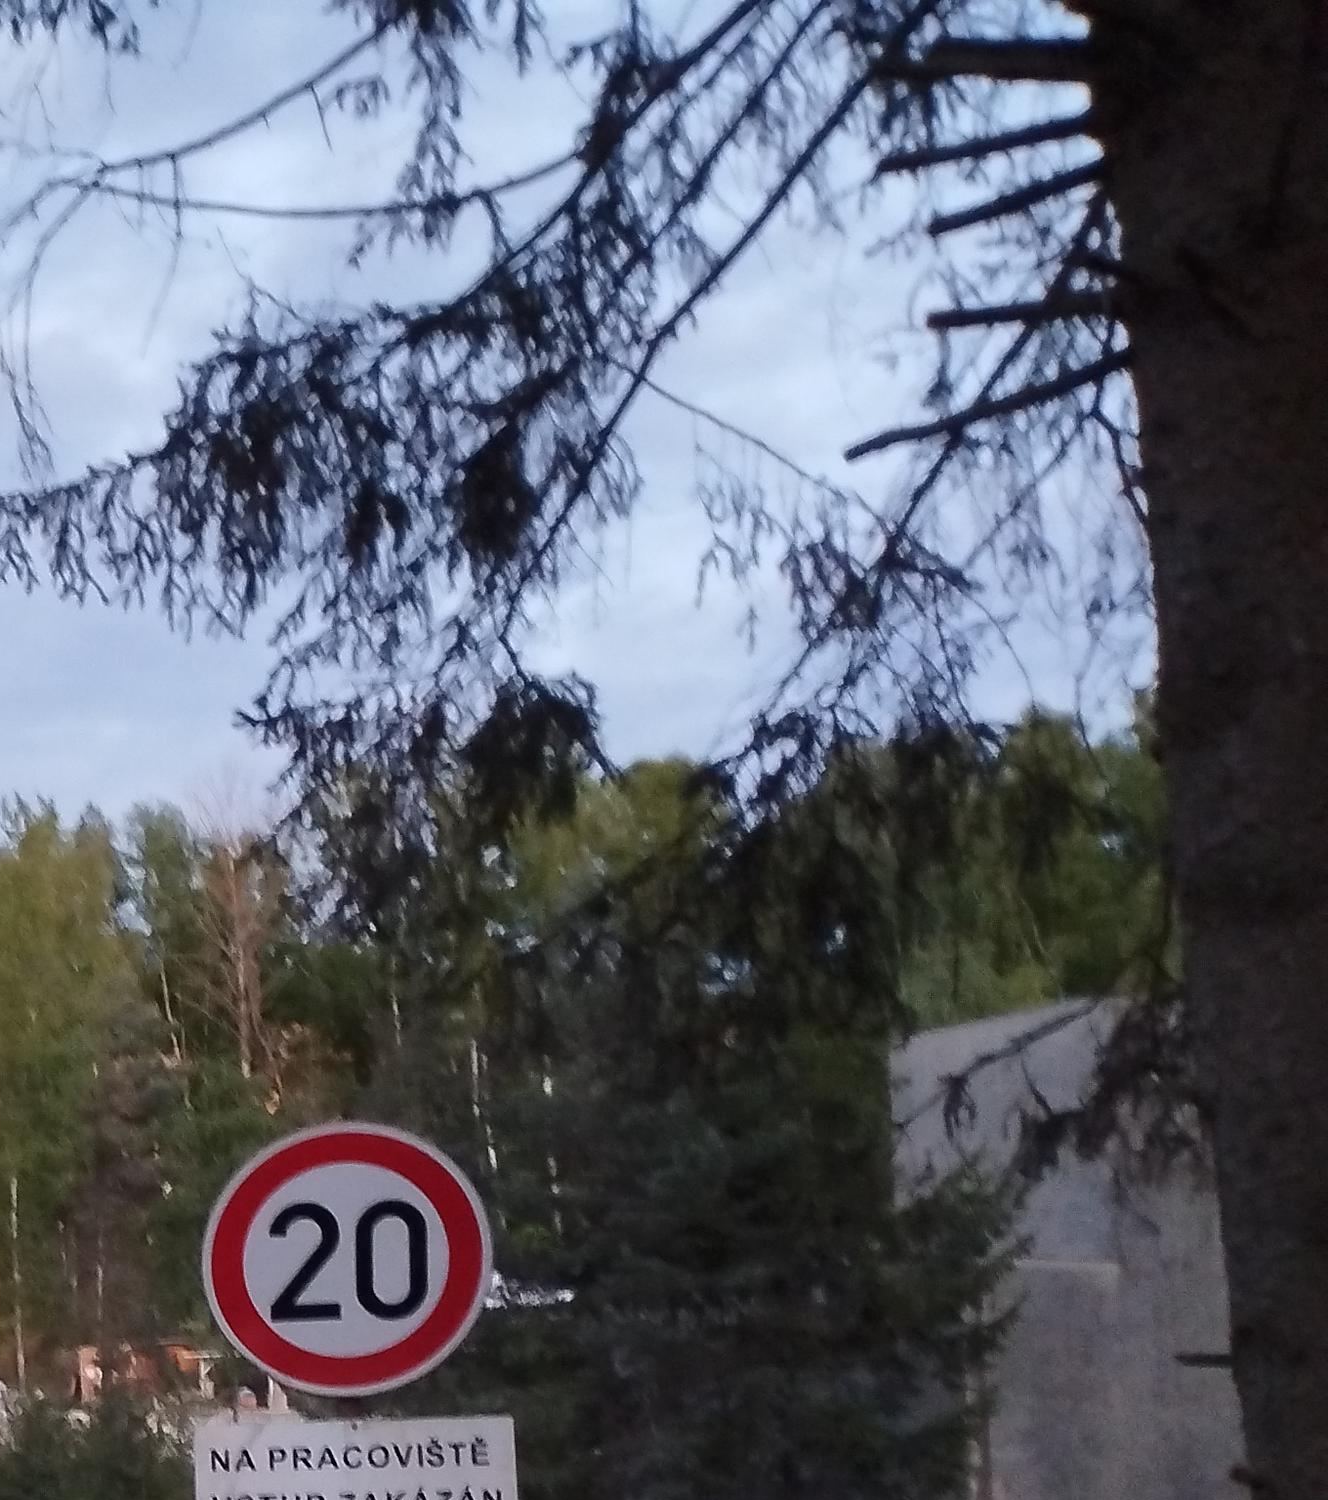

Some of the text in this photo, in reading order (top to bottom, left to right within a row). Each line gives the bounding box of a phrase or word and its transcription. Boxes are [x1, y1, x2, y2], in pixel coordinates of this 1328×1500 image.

[269, 1200, 428, 1321] 20
[210, 1436, 490, 1472] NA PRACOVIŠTĚ
